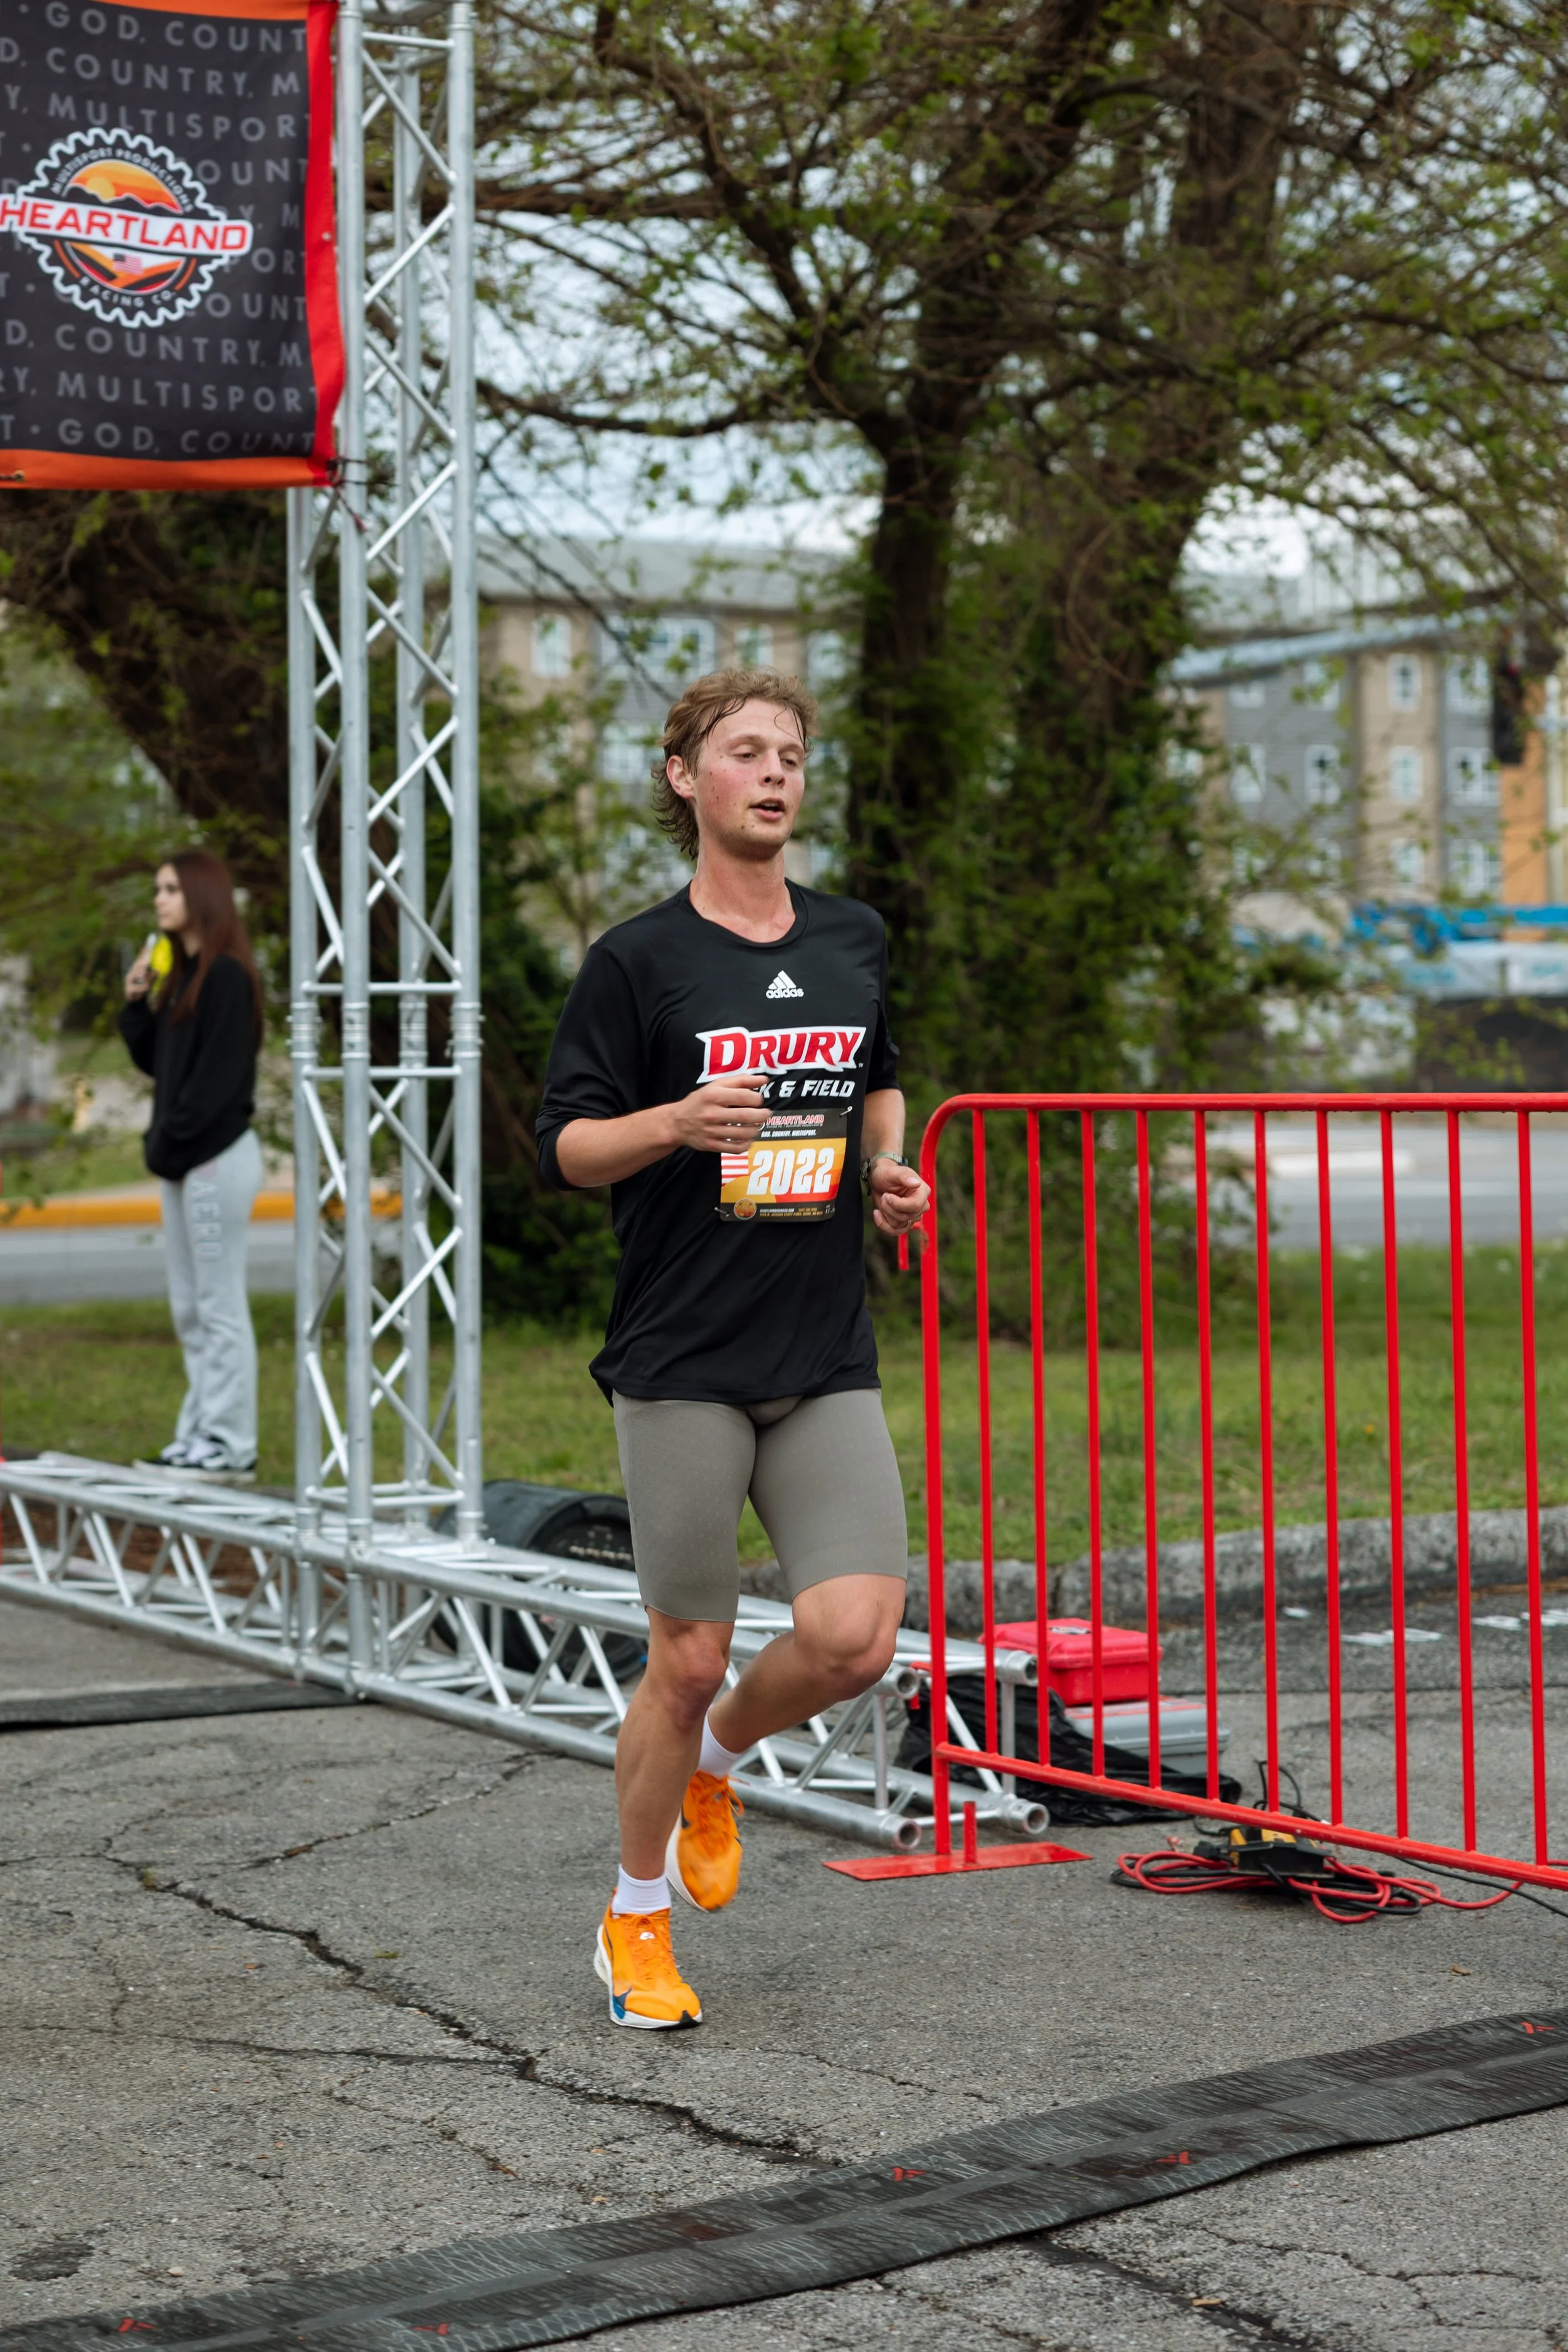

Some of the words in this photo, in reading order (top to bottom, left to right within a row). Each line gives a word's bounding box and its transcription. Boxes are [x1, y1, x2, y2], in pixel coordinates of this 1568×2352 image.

[48, 92, 310, 142] MULTISPOR
[0, 200, 247, 251] HEARTLAND
[55, 324, 266, 368] COUNTRY,
[58, 418, 160, 453] GOD,
[766, 987, 804, 999] adidas
[707, 1032, 861, 1076] DRURY
[779, 1080, 796, 1098] &
[801, 1079, 856, 1098] FIELD
[766, 1114, 824, 1126] HEARTLAND
[746, 1147, 835, 1195] 2022
